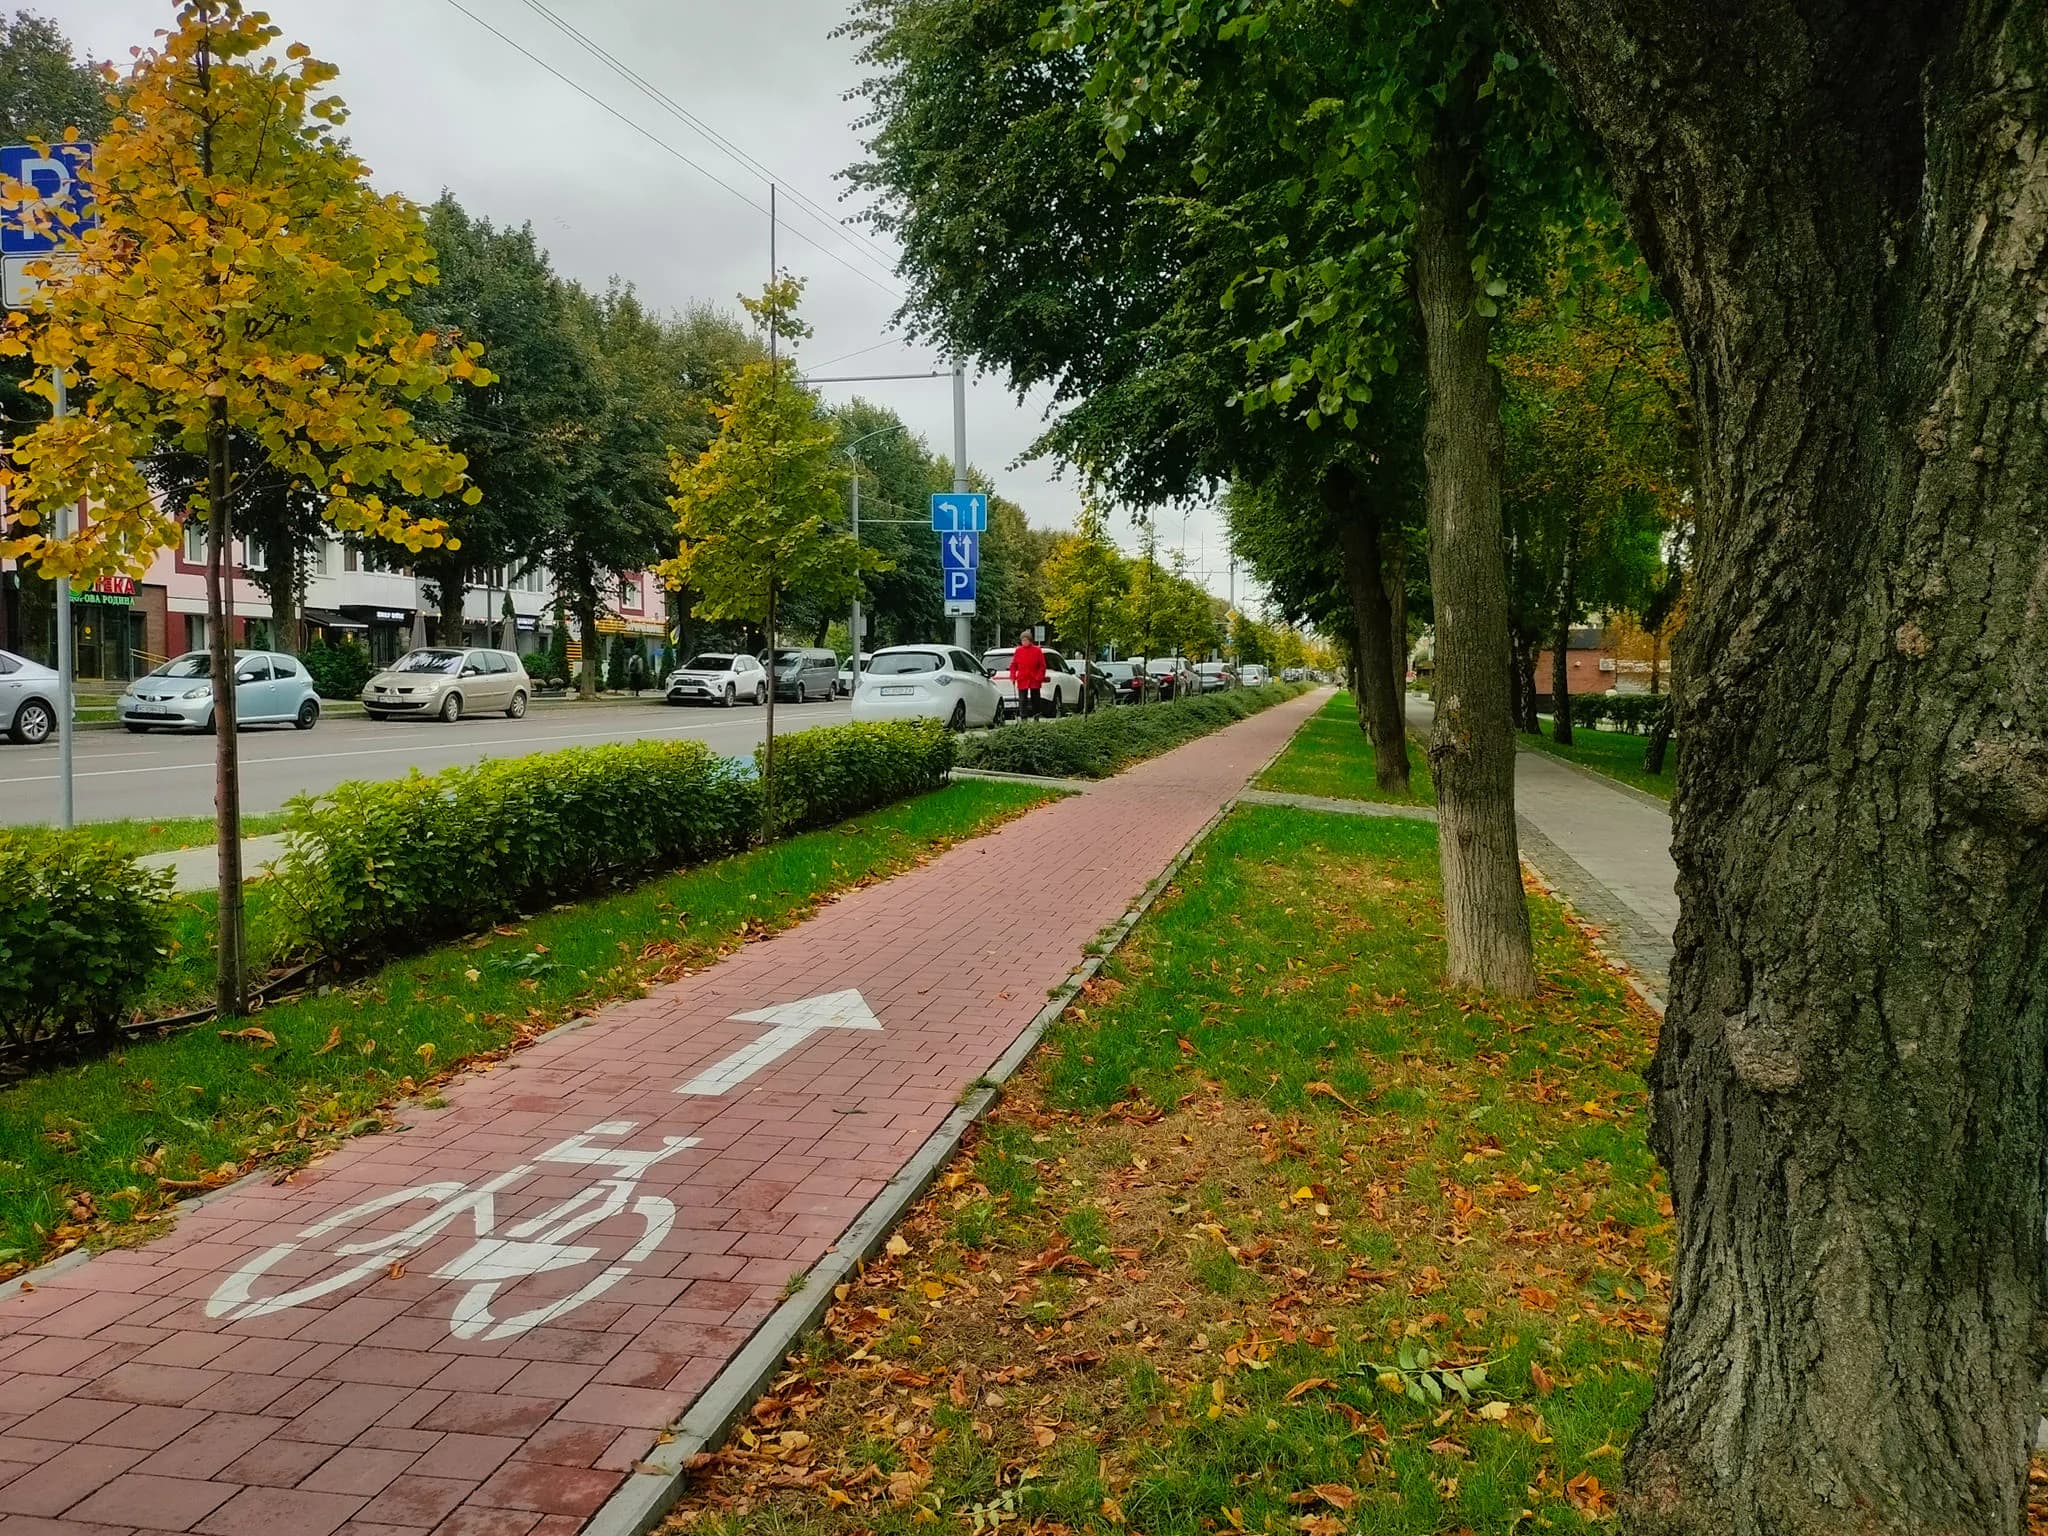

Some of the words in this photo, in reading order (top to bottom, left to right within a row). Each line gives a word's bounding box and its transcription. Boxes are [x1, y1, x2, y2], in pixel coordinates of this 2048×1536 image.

[21, 158, 71, 239] P
[94, 576, 136, 595] ТЕКА
[951, 572, 969, 597] P
